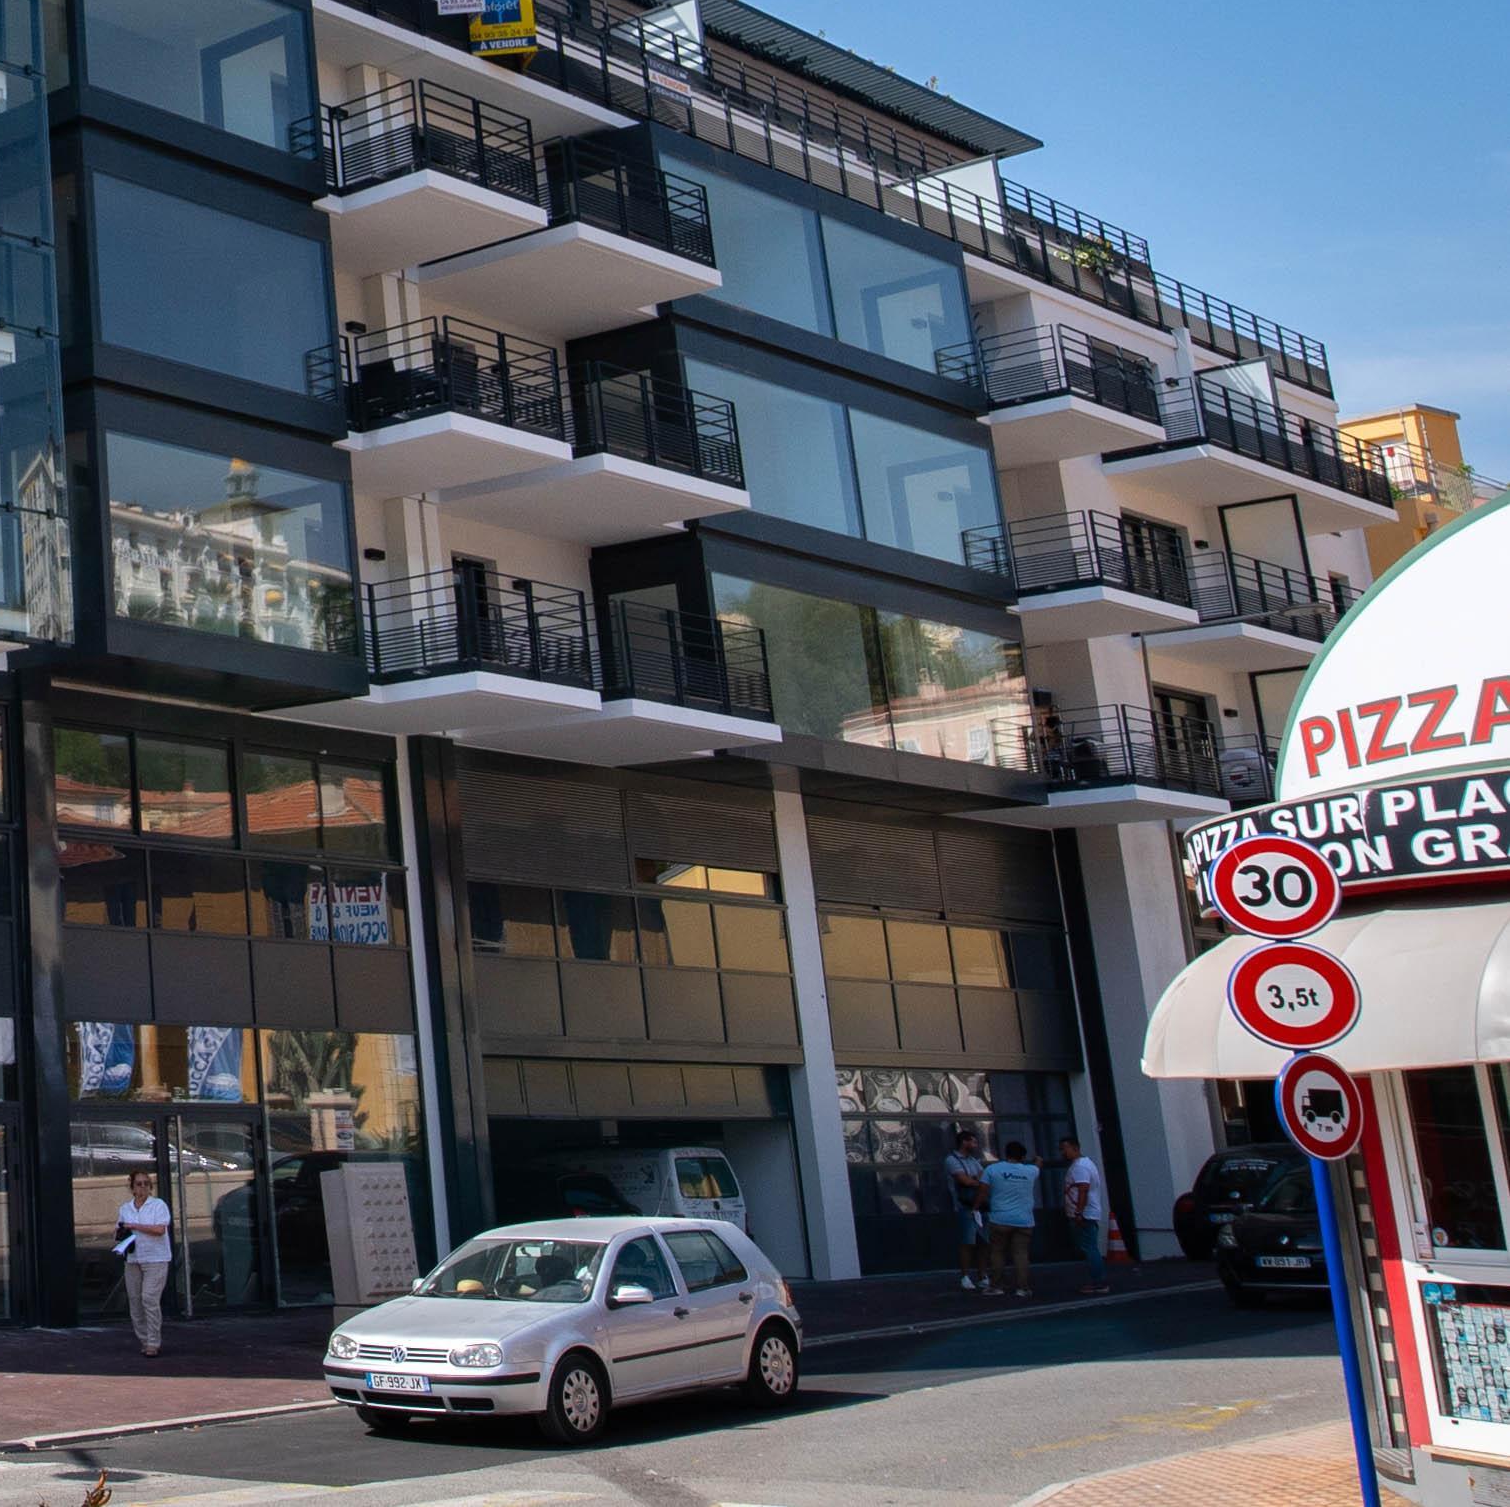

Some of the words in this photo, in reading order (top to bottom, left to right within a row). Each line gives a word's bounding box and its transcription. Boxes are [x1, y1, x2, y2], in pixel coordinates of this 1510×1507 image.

[489, 38, 529, 49] VENDRE
[1300, 676, 1510, 778] PIZZA
[1270, 797, 1363, 839] SUR
[1382, 779, 1510, 827] PLA
[1411, 824, 1510, 866] GR
[1237, 864, 1313, 909] 30
[1267, 984, 1320, 1012] 3,5t
